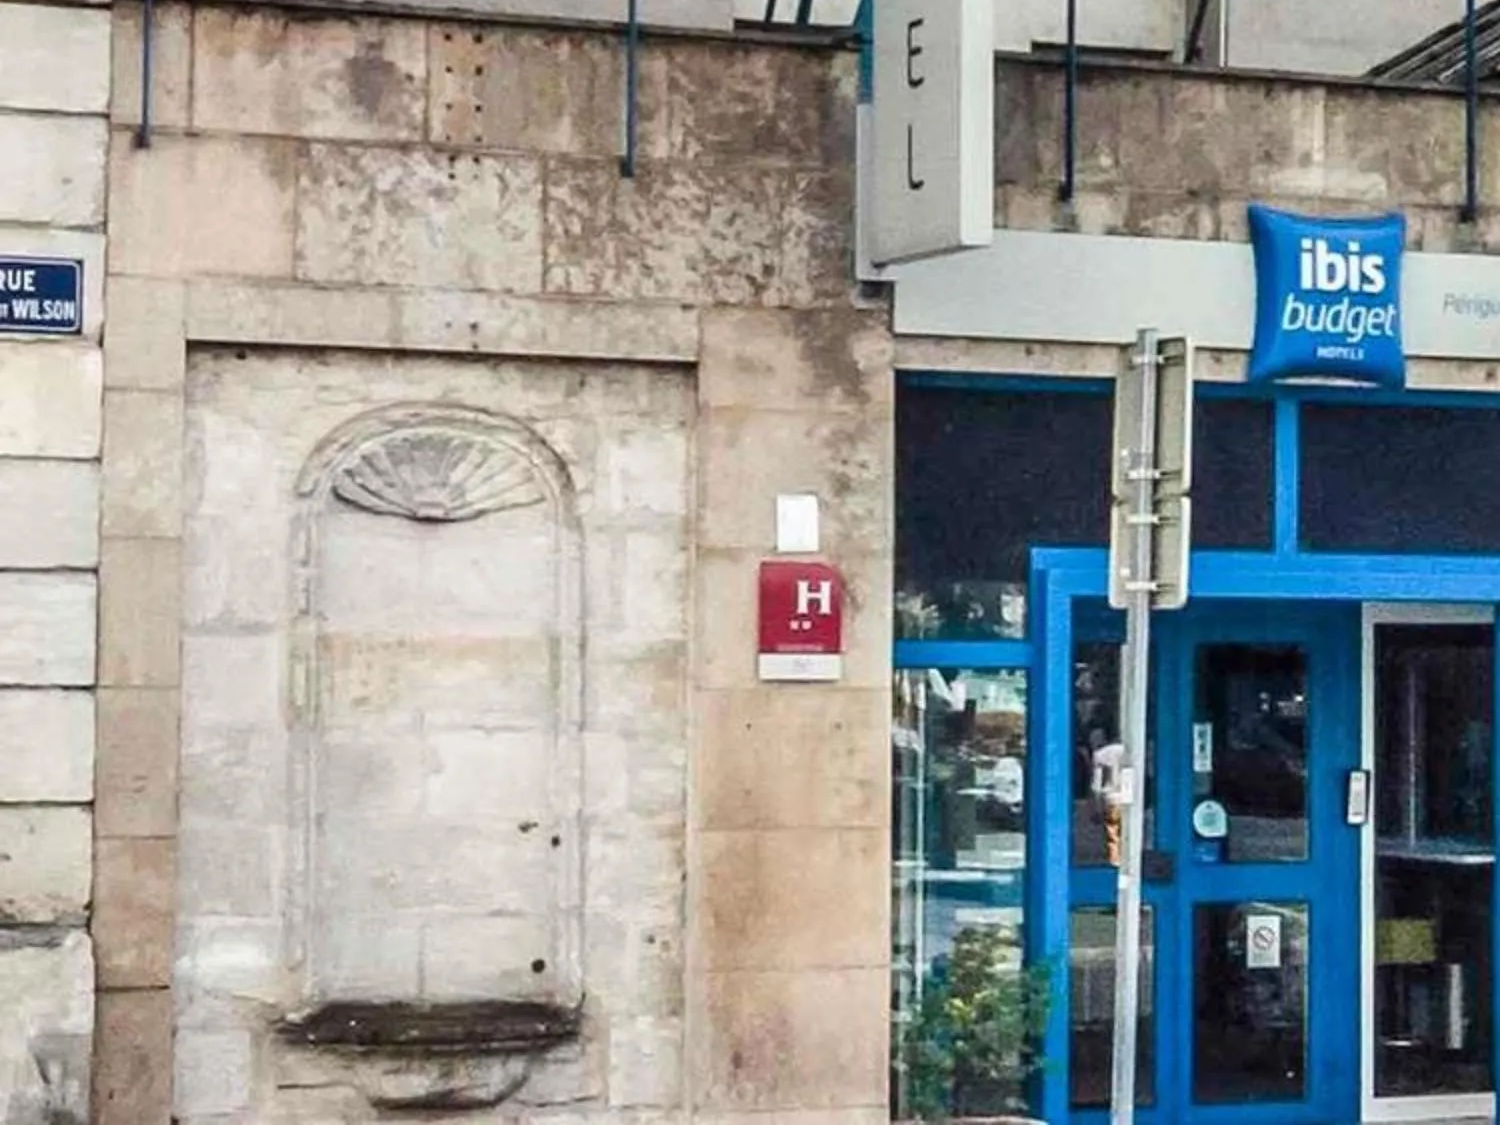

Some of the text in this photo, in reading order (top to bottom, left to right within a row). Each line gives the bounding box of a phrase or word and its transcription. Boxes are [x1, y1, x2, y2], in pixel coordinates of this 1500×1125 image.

[1301, 237, 1386, 294] ibis
[12, 298, 76, 320] WILSON
[1280, 292, 1397, 343] budget
[1316, 346, 1365, 360] HOTELS
[797, 580, 832, 615] H
